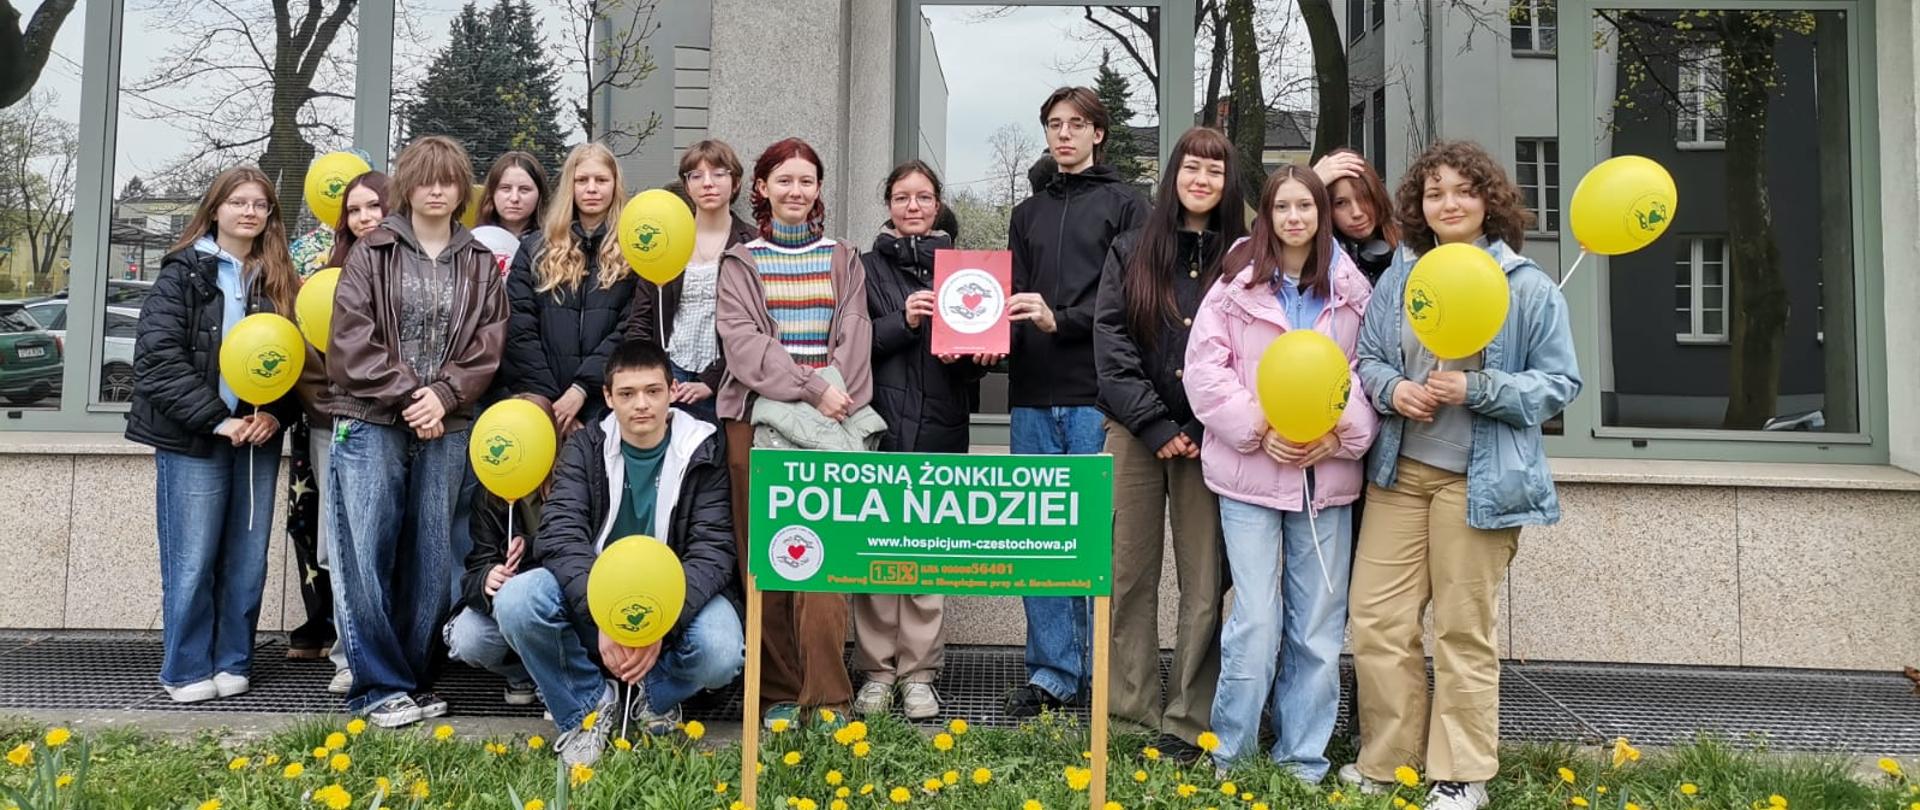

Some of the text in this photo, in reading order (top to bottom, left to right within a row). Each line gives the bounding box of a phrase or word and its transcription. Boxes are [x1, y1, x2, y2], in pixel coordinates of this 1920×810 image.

[784, 461, 1070, 489] TU ROSNĄ ŻONKILOWE
[769, 485, 1079, 525] POLA NADZIEI
[868, 536, 1077, 552] www.hospicjum-czestochowa.pl
